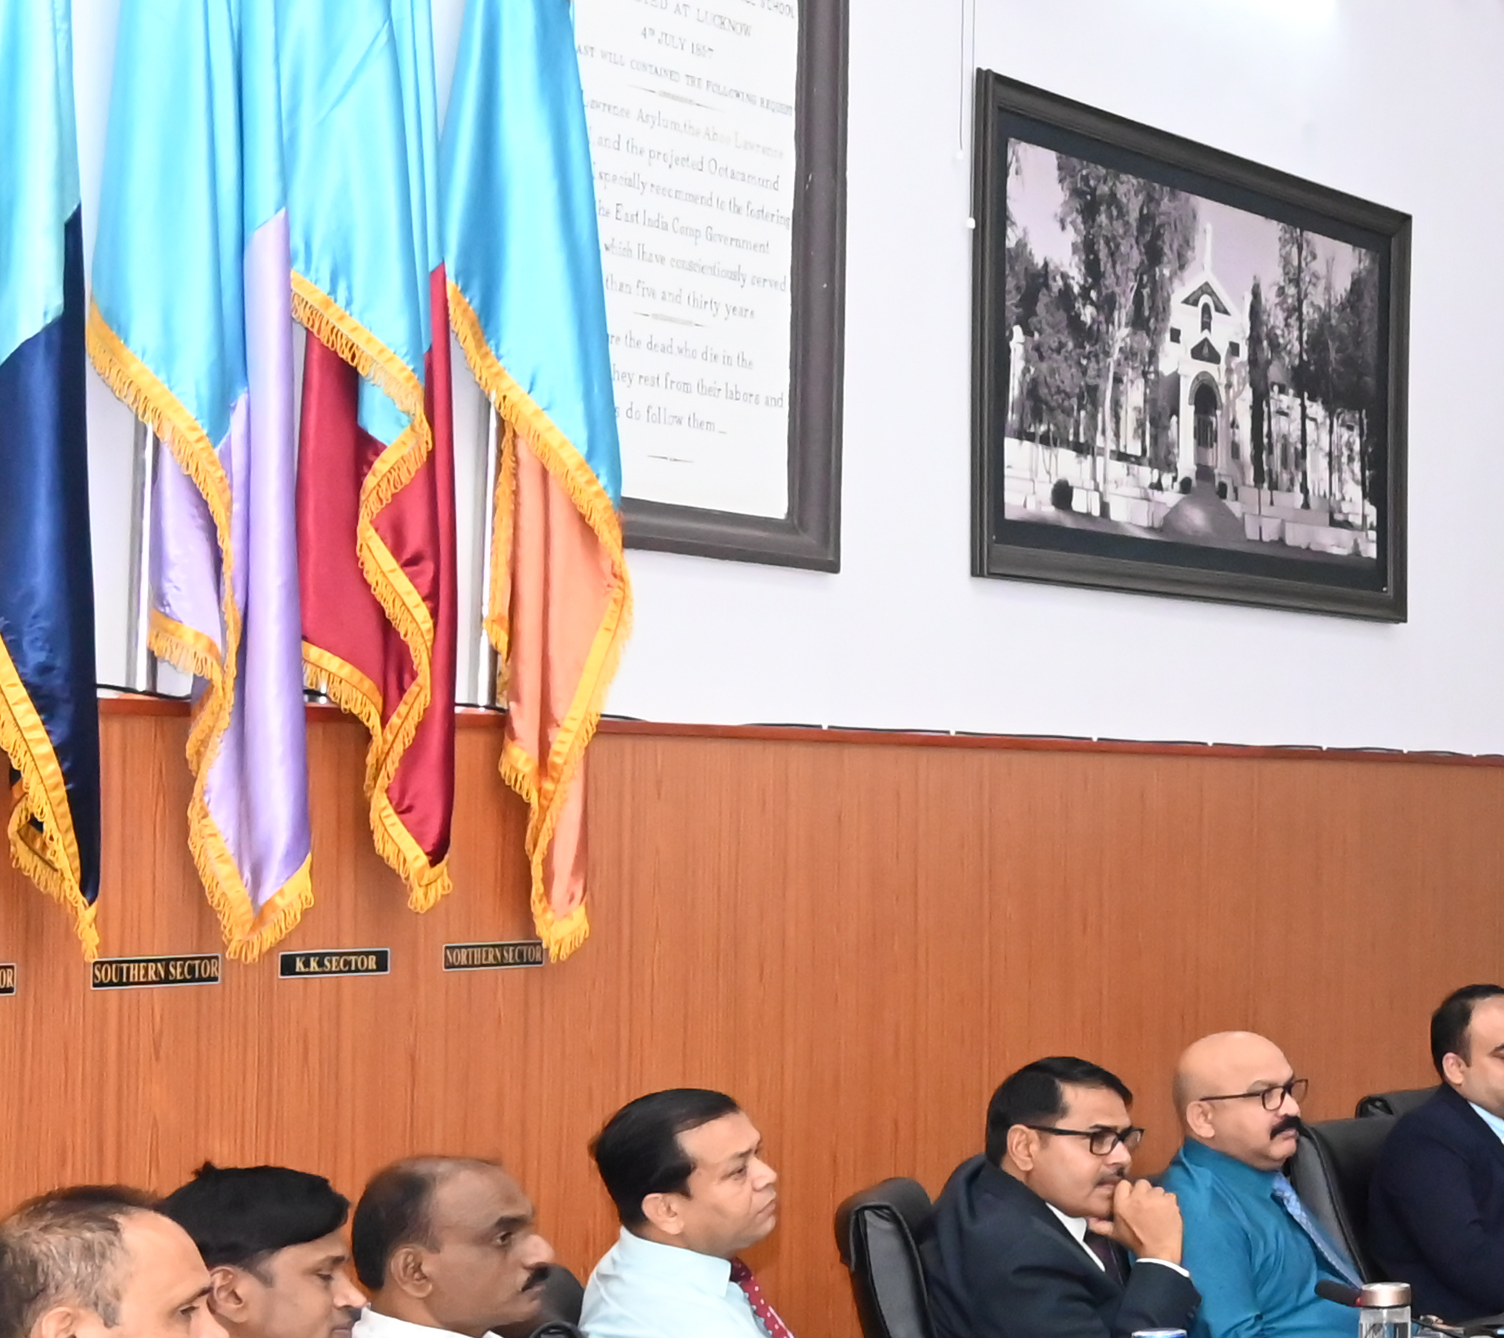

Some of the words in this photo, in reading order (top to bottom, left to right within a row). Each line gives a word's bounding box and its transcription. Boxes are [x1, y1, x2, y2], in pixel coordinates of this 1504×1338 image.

[674, 3, 690, 18] AT
[697, 9, 752, 37] LUCKNOW
[658, 32, 687, 51] JULY
[324, 954, 377, 972] SECTOR
[446, 947, 501, 966] NORTHERN
[503, 945, 542, 964] SECTOR
[94, 960, 165, 985] SOUTHERN
[168, 958, 219, 981] SECTOR
